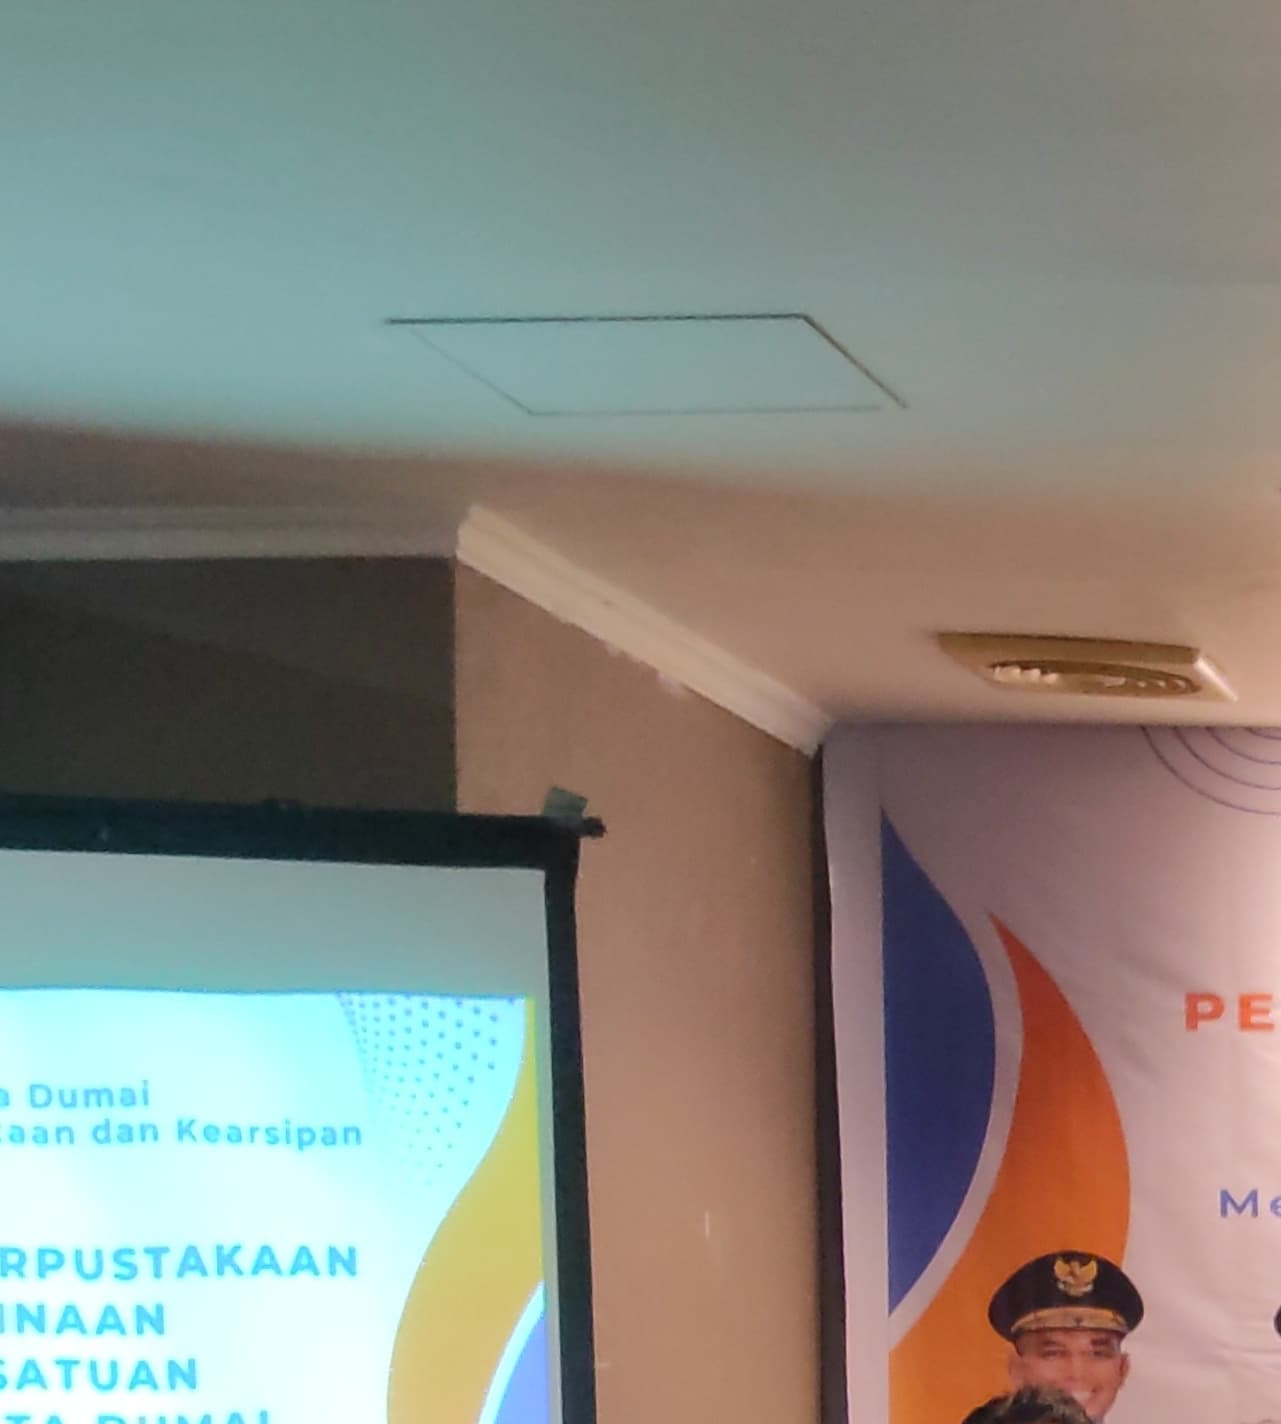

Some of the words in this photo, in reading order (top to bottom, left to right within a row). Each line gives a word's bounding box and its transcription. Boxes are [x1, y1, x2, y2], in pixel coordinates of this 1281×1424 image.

[29, 1080, 150, 1109] Dumai
[0, 1122, 75, 1145] aan
[92, 1118, 159, 1143] dan
[176, 1118, 363, 1151] Kearsipan
